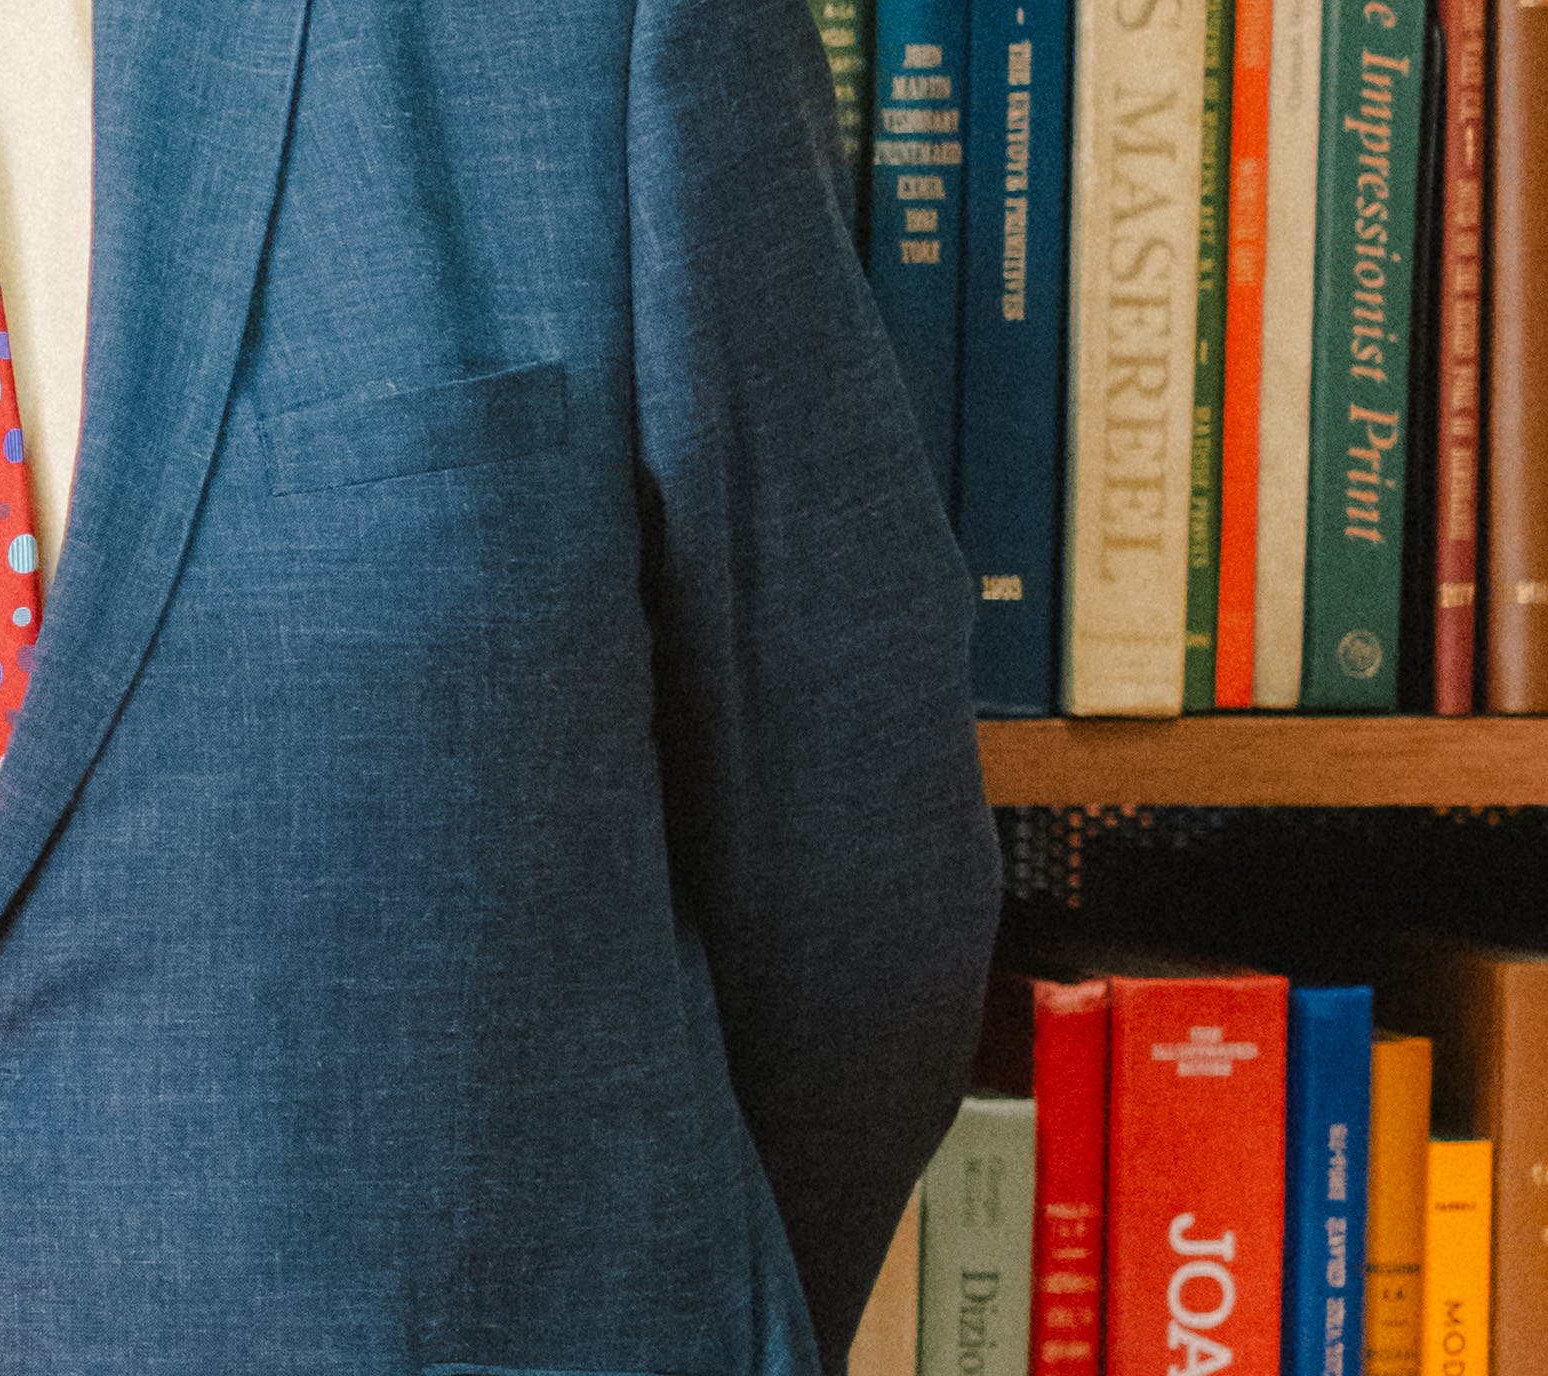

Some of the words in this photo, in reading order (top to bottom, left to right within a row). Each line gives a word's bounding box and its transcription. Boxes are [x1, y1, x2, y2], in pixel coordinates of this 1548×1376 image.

[1101, 84, 1180, 583] MASEREEL
[1343, 49, 1412, 381] Impressionist
[1346, 401, 1402, 550] Print
